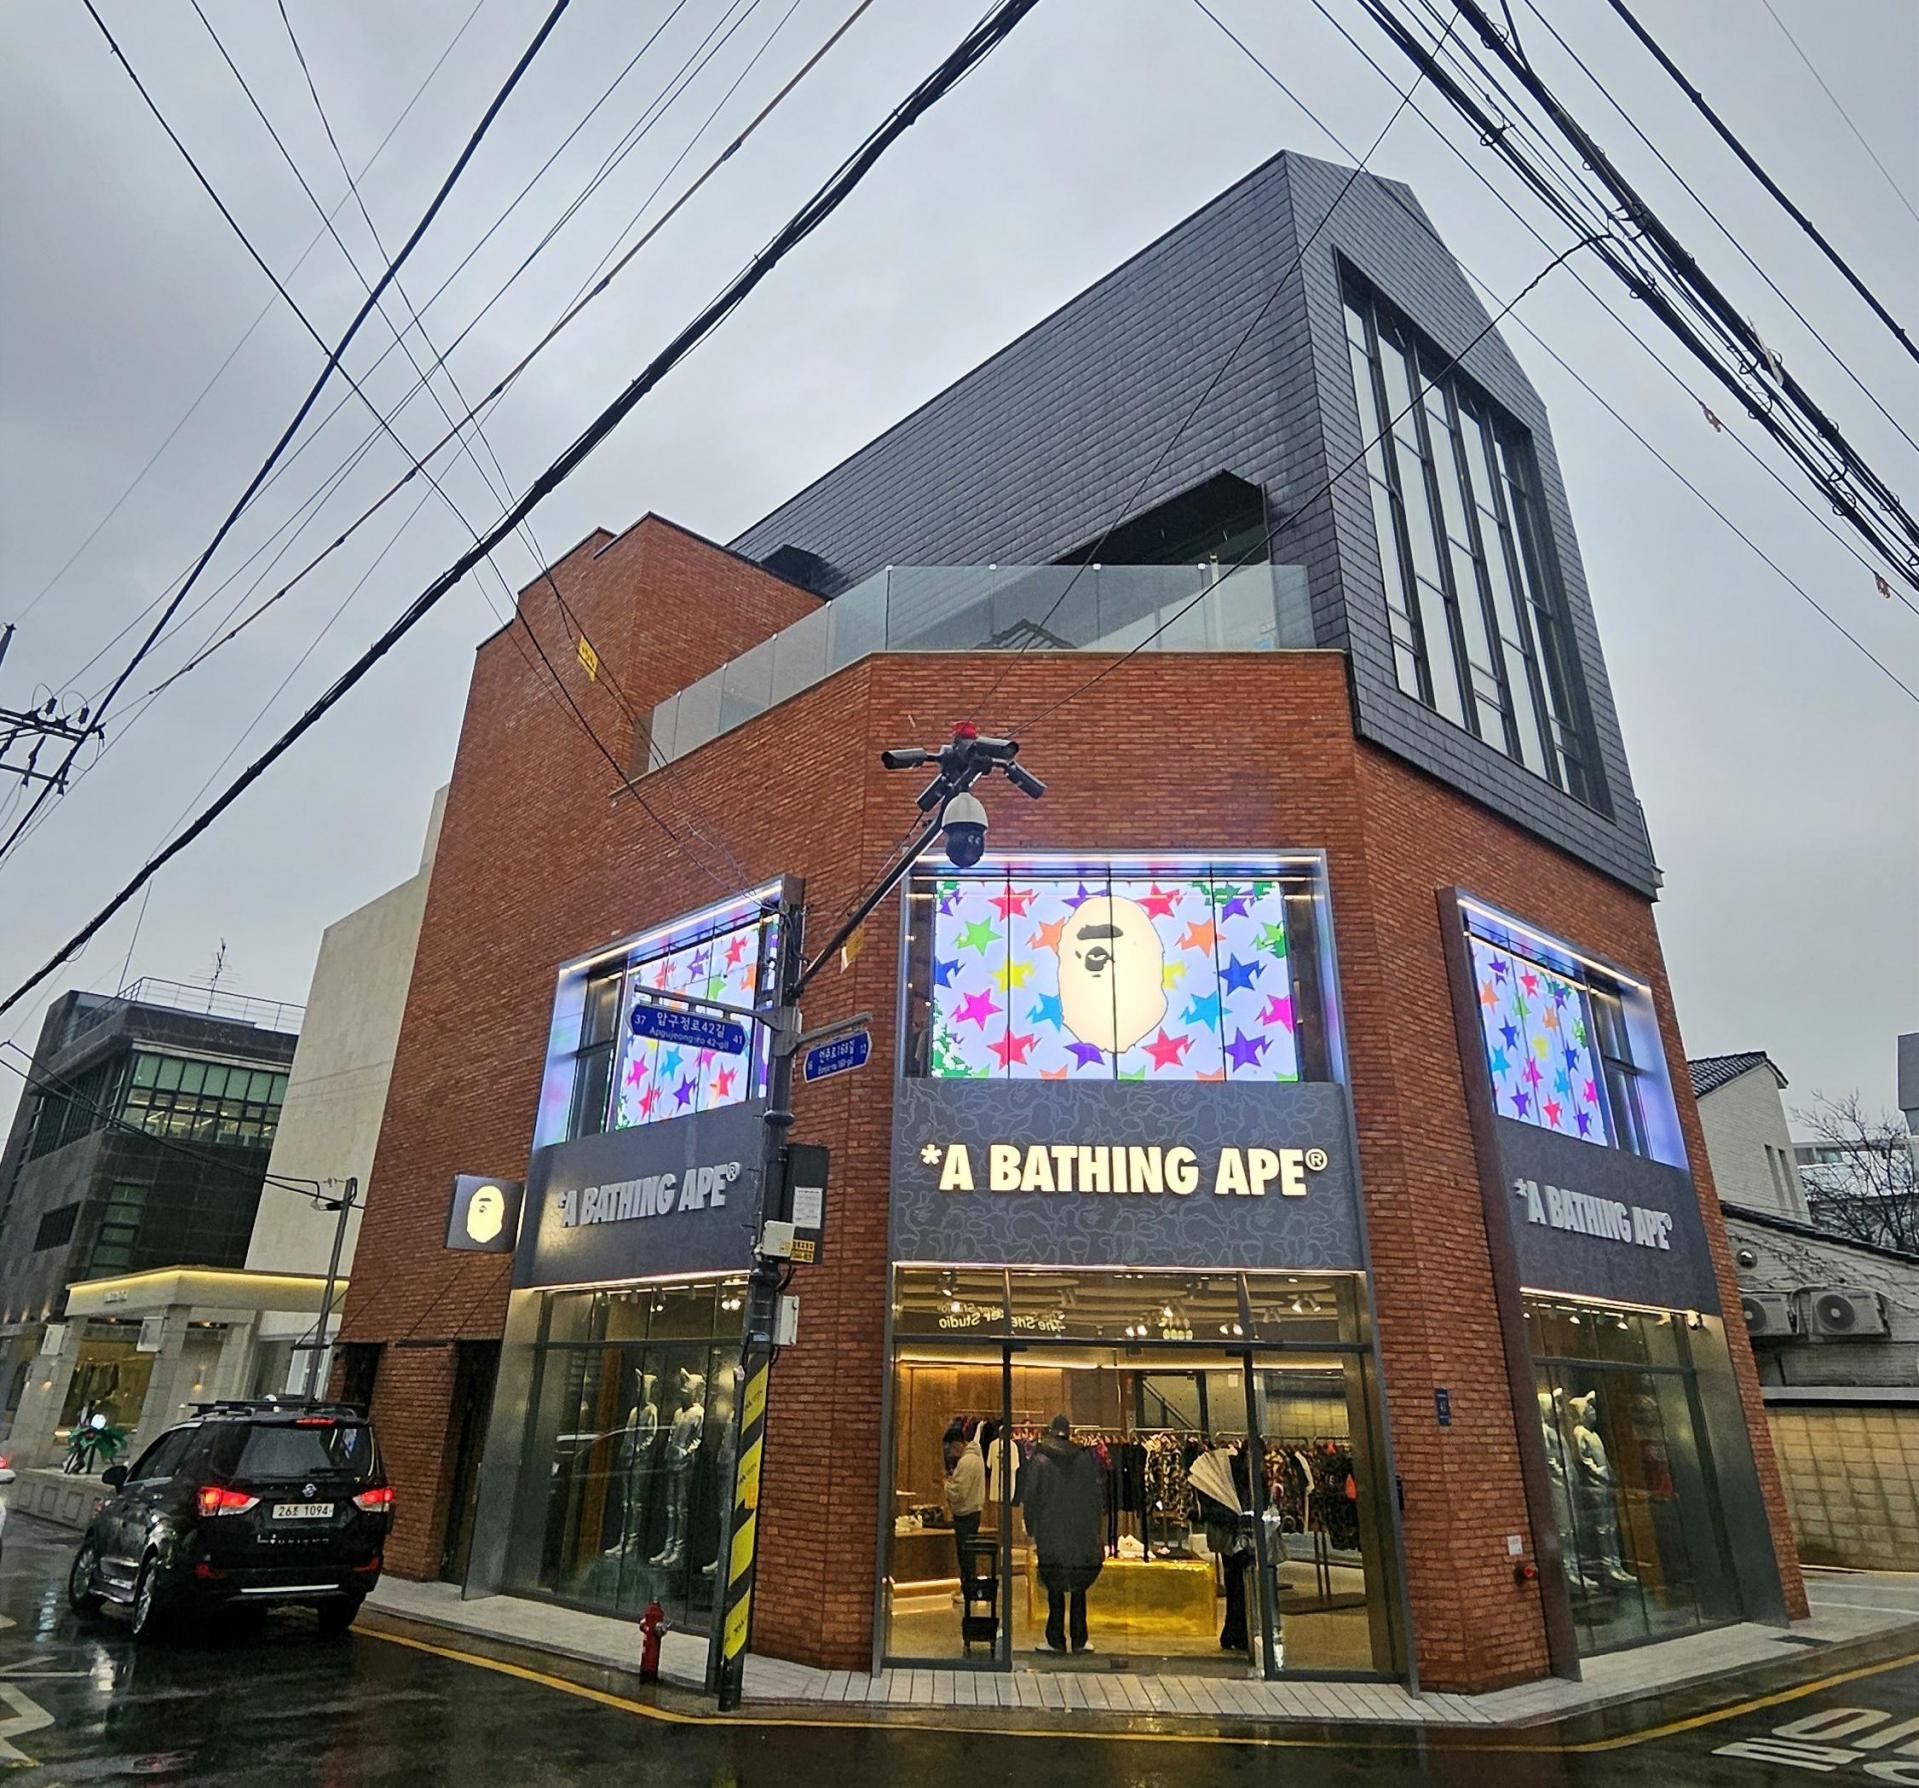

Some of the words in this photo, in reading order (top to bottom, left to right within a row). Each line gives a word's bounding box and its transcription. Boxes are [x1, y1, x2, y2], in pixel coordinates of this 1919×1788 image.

[634, 1014, 646, 1025] 37
[657, 1011, 726, 1039] 압구정로42길
[732, 1034, 743, 1045] 41
[989, 1143, 1200, 1196] BATHING
[579, 1173, 677, 1226] BATHING
[1543, 1185, 1632, 1244] BATHING
[304, 1504, 329, 1516] 1094
